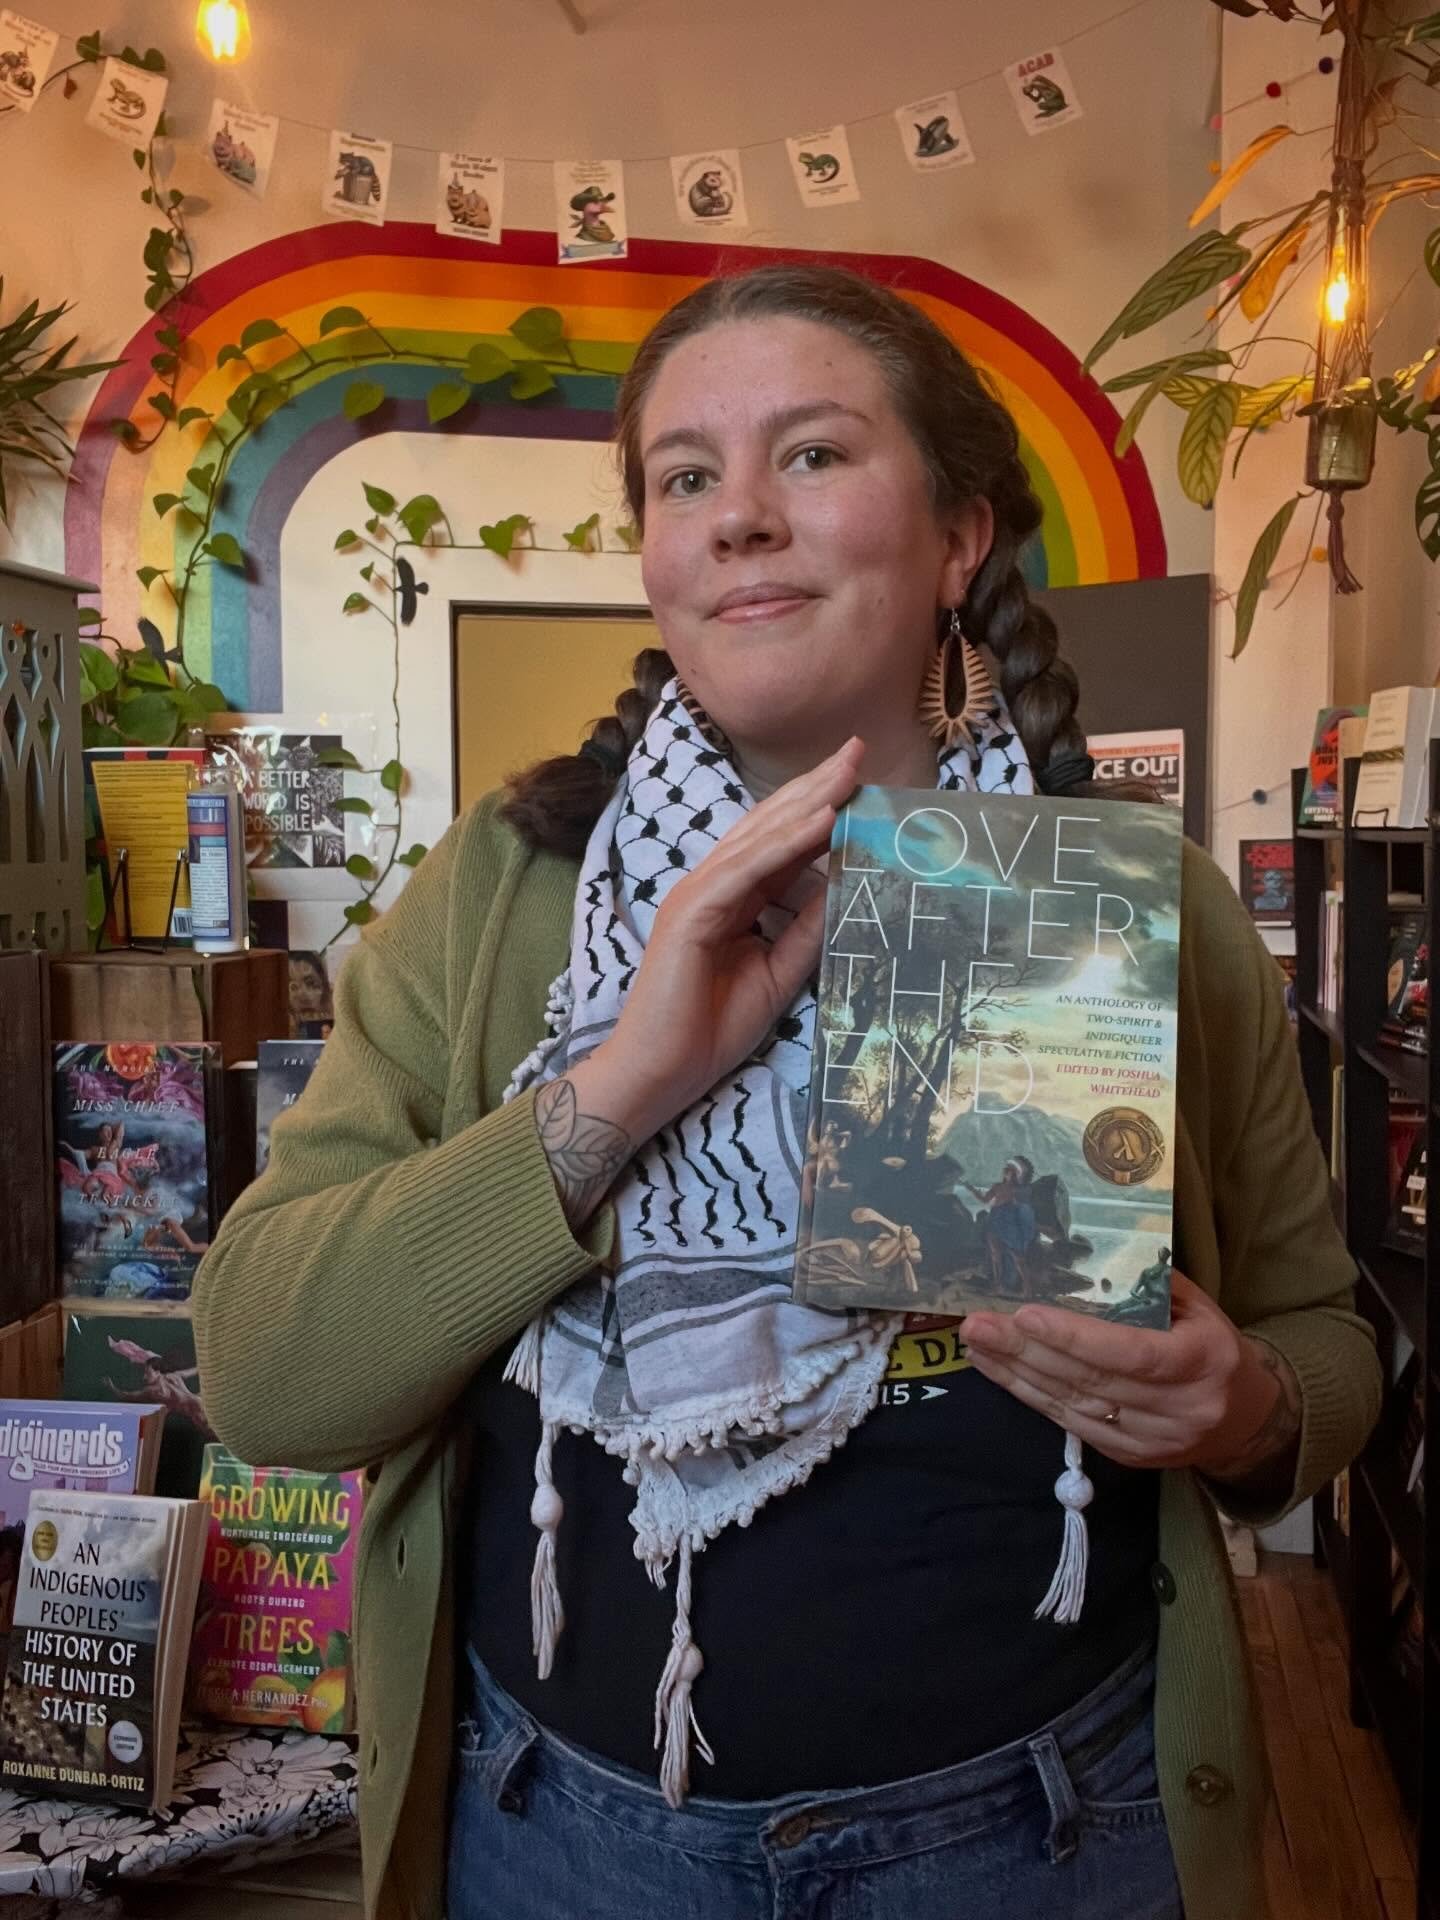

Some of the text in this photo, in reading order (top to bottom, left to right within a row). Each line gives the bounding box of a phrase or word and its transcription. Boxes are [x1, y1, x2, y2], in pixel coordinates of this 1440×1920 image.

[1018, 53, 1055, 77] ACAB
[1131, 756, 1178, 777] OUT
[259, 770, 311, 788] BETTER
[296, 794, 310, 810] IS
[245, 814, 311, 832] POSSIBLE
[842, 807, 1101, 887] LOVE
[830, 876, 1139, 966] AFTER
[829, 952, 1015, 1034] THE
[1056, 995, 1162, 1012] AN ANTHOLOGY OF
[1087, 1014, 1162, 1029] TWO-SPIRIT &
[1086, 1031, 1162, 1046] INDIGIQUEER
[1037, 1045, 1162, 1063] SPECULATIVE FICTION
[822, 1030, 1033, 1114] END
[1056, 1063, 1160, 1081] EDITED BY JOSHUA
[1090, 1083, 1161, 1098] WHITEHEAD
[73, 1100, 180, 1113] MISS CHIEF
[96, 1146, 156, 1160] EAGLE
[211, 1484, 350, 1530] GROWING
[220, 1528, 333, 1544] NURTURING INDIGENOUS
[73, 1542, 100, 1566] AN
[212, 1547, 330, 1590] PAPAYA
[30, 1567, 146, 1603] INDIGENOUS
[268, 1596, 305, 1608] DURING
[217, 1612, 314, 1654] TREES
[25, 1629, 137, 1667] HISTORY OF
[249, 1661, 320, 1676] DISPLACEMENT
[23, 1661, 136, 1698] THE UNITED
[41, 1696, 108, 1727] STATES
[2, 1760, 145, 1792] ROXANNE DUNBAR-ORTIZ
